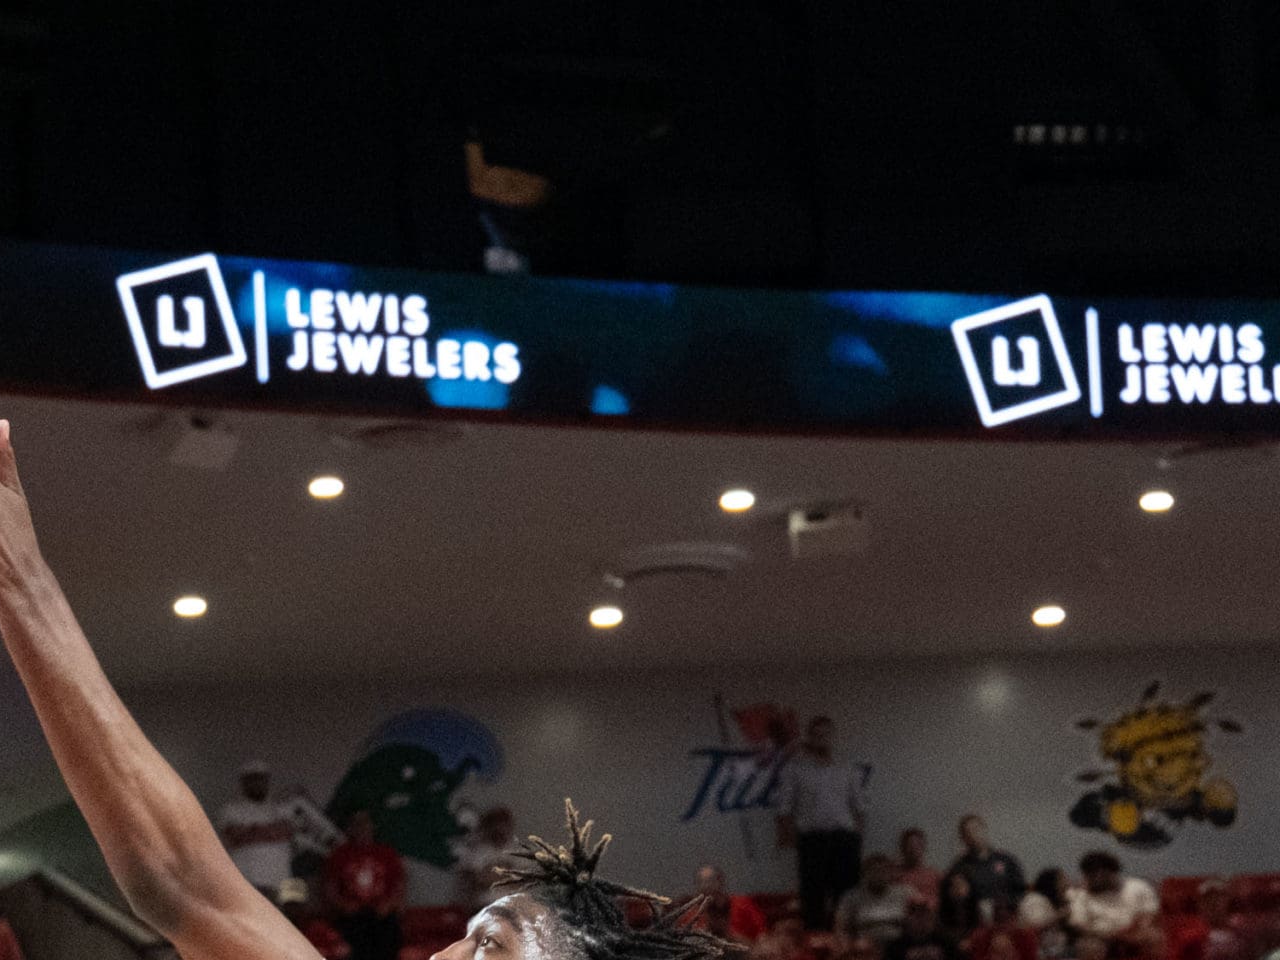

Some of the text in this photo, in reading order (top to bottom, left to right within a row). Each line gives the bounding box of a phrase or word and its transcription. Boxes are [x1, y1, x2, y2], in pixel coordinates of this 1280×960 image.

[284, 287, 430, 337] LEWIS
[286, 329, 521, 384] JEWELERS
[1117, 323, 1265, 364] LEWIS
